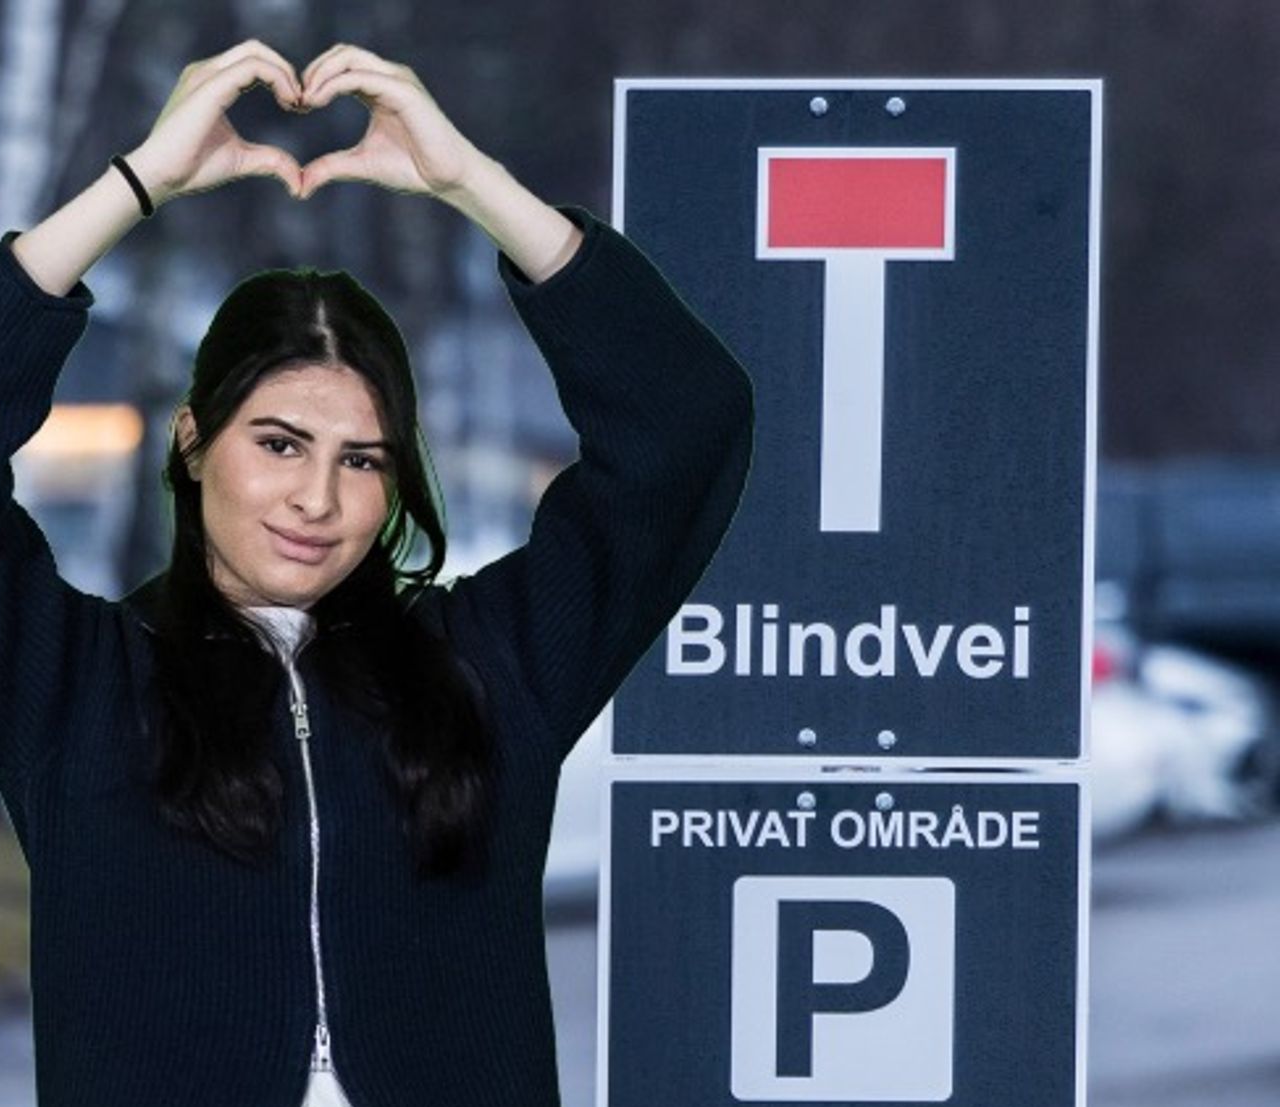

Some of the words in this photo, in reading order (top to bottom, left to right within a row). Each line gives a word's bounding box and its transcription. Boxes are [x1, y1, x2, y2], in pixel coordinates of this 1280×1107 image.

[666, 603, 1030, 679] Blindvei
[651, 809, 817, 848] PRIVAT
[830, 804, 1040, 849] OMRÅDE
[775, 898, 912, 1079] P
